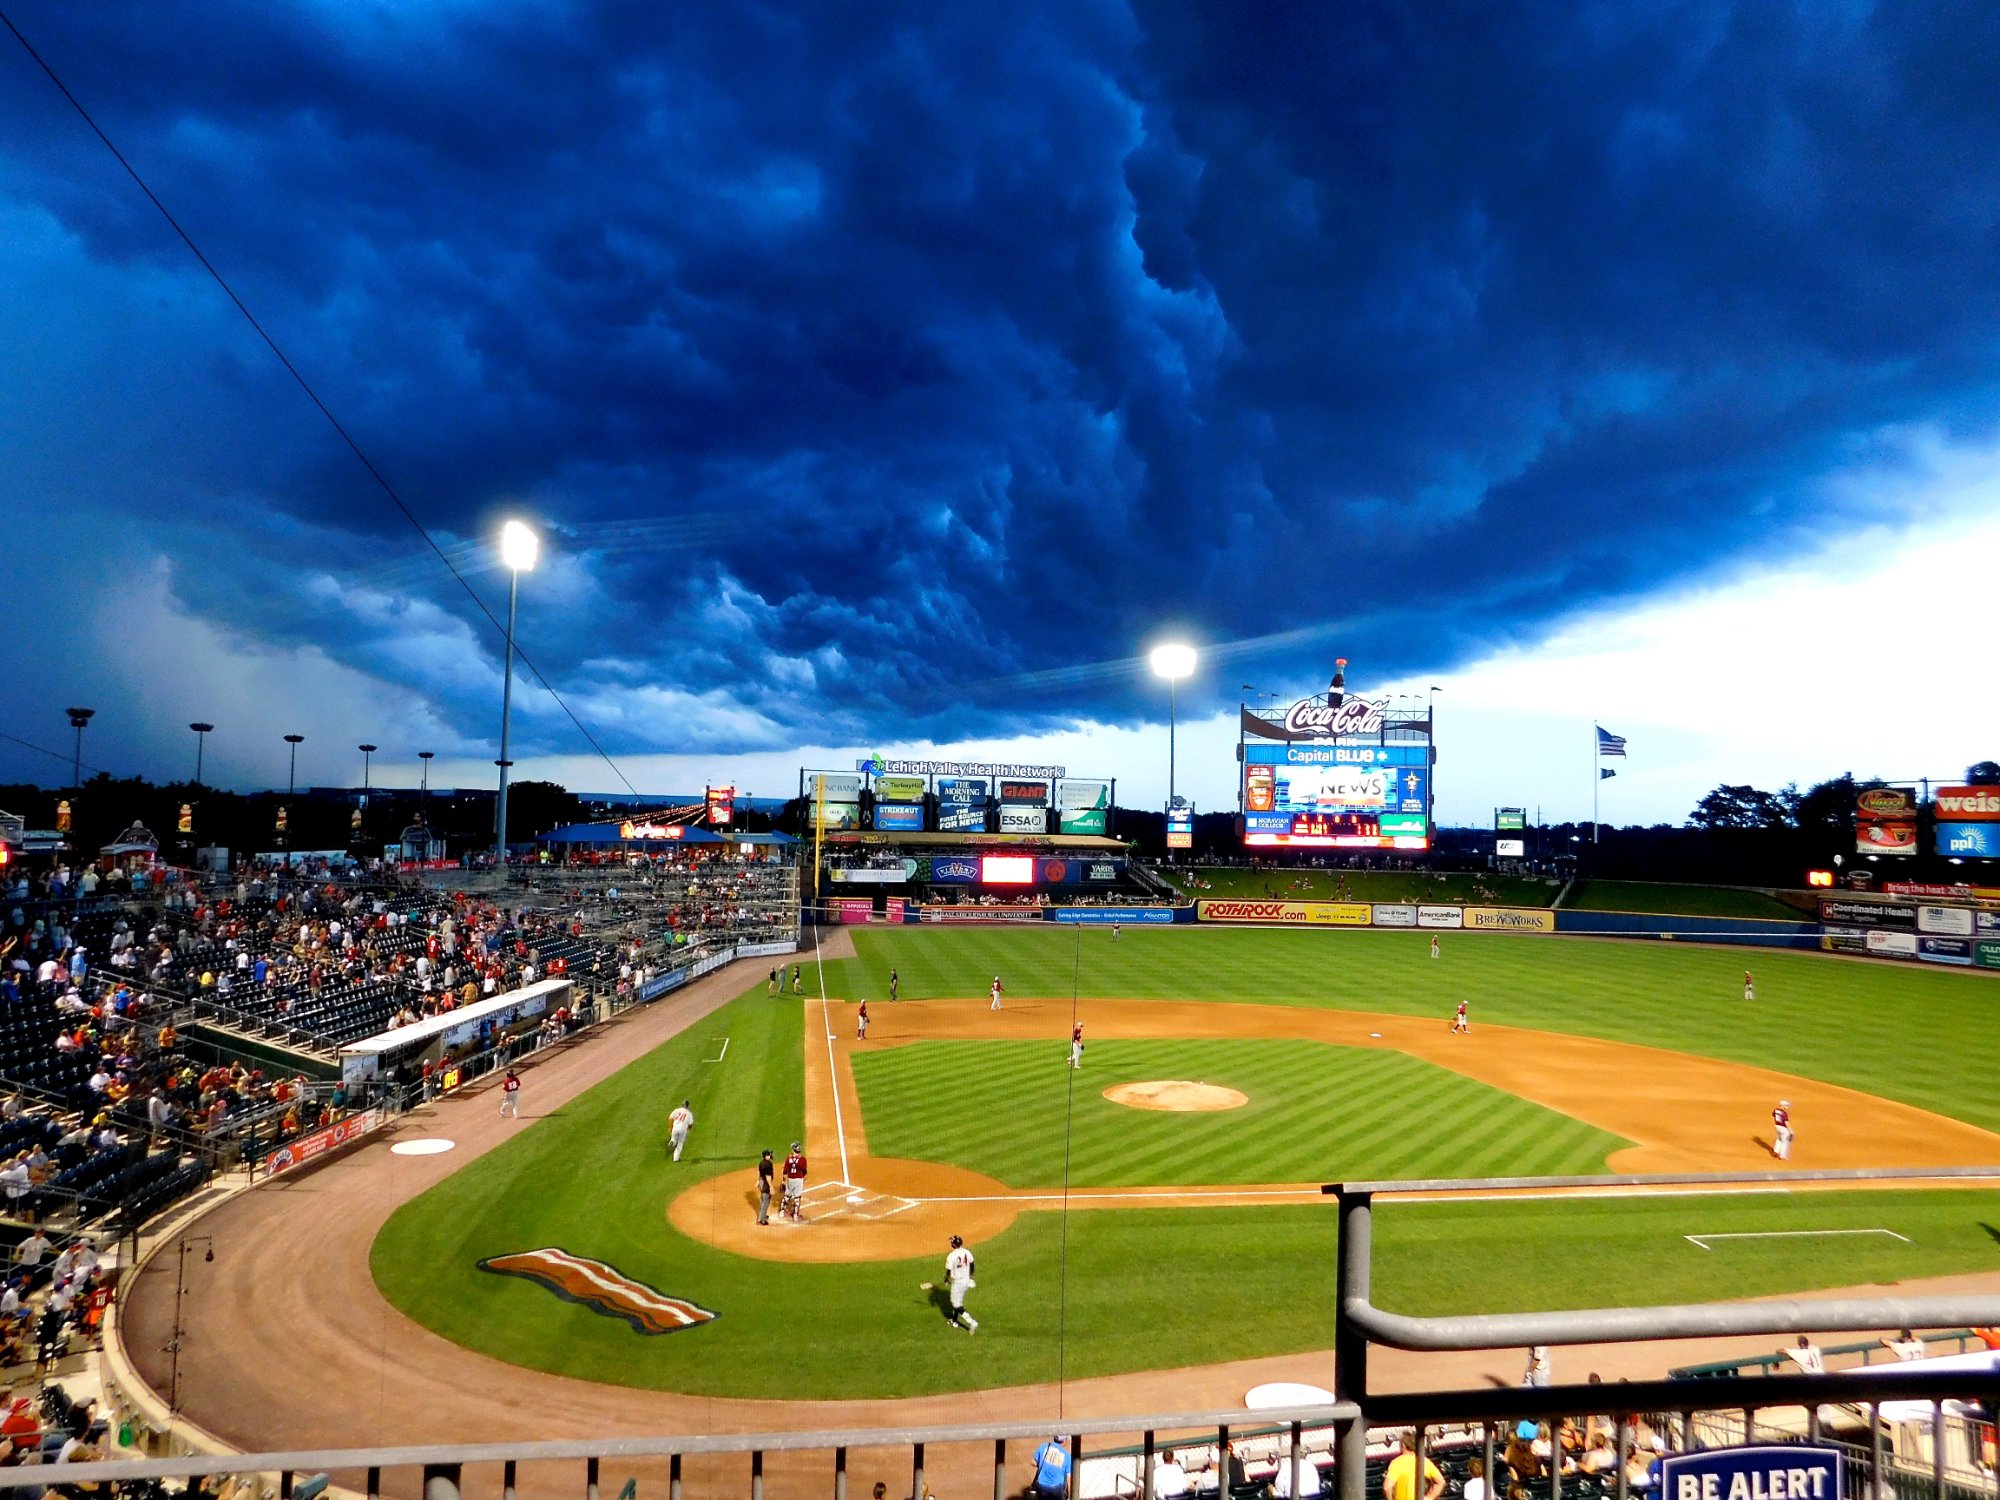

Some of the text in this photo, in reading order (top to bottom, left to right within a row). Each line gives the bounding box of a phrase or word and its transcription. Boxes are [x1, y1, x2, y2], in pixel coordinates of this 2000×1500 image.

[1285, 698, 1388, 734] Coca-Cola
[1288, 749, 1334, 764] Capital
[885, 760, 1062, 778] Lehigh Valley Health Network
[944, 788, 980, 796] MORNING
[1002, 786, 1046, 798] GIANT
[1937, 792, 2000, 812] weis
[958, 811, 984, 820] SOURCE
[1002, 816, 1031, 825] ESSA
[940, 817, 984, 830] FOR NEWS
[1950, 836, 1972, 851] ppl
[1887, 883, 1909, 893] Bring
[1911, 885, 1924, 893] the
[1926, 885, 1945, 894] heat
[1833, 904, 1913, 916] Coordinated Health
[1678, 1466, 1828, 1500] BE ALERT
